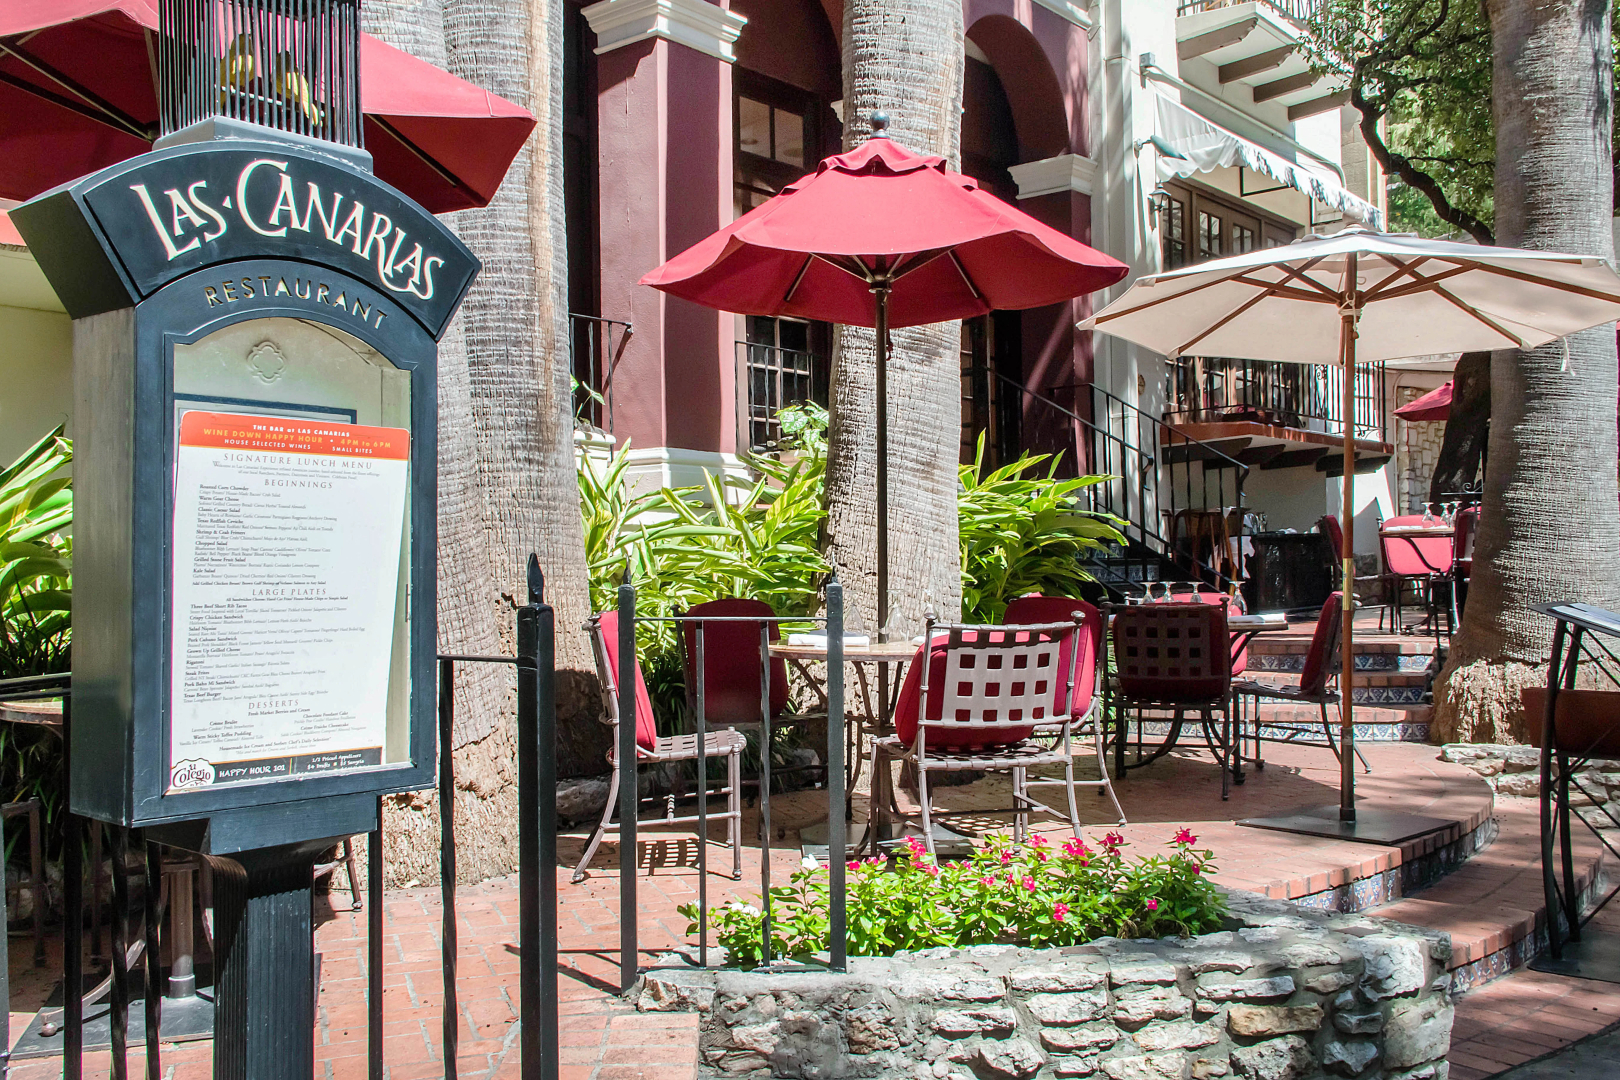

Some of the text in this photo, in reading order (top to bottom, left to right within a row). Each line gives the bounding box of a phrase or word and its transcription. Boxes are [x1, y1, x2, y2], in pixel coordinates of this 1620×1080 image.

[130, 159, 444, 300] LAS CANARIAS
[203, 276, 389, 331] RESTAURANT
[232, 431, 261, 439] DOWN
[265, 433, 294, 441] HAPPY
[224, 453, 372, 469] SIGNATURE LUNCH MENU
[264, 479, 333, 489] BEGINNINGS
[248, 700, 299, 709] DESSERTS
[173, 768, 210, 787] Colegio
[219, 768, 248, 777] HAPPY
[250, 766, 271, 774] HOUR
